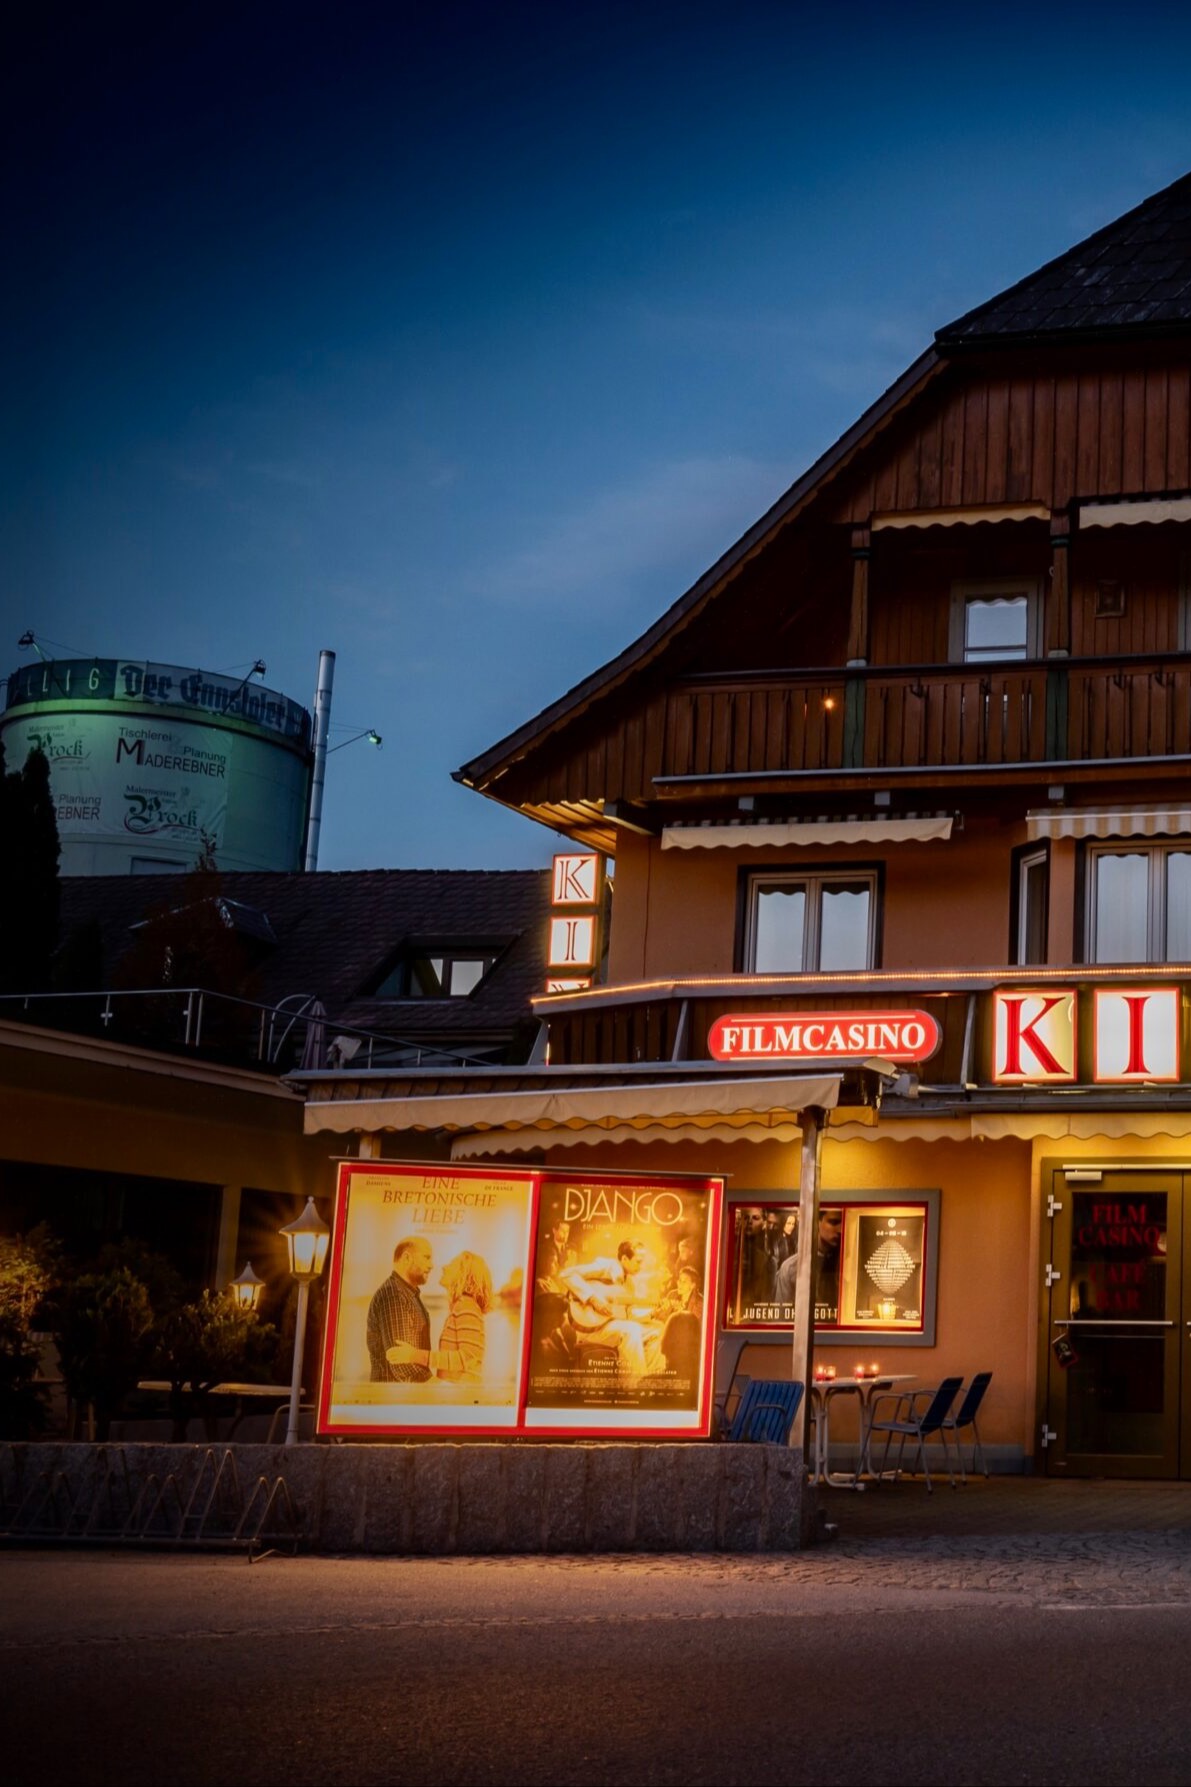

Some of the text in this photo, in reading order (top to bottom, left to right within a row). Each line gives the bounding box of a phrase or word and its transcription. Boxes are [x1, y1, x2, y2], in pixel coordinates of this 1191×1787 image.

[120, 664, 171, 700] Der
[120, 727, 172, 741] Tischlerei
[116, 738, 225, 779] MADEREBNER
[183, 746, 226, 764] Planung
[56, 806, 99, 820] EBNER
[720, 1022, 926, 1053] FILMCASINO
[421, 1177, 460, 1190] EINE
[382, 1189, 497, 1207] BRETONISCHE
[563, 1187, 684, 1226] DJANGO
[412, 1207, 467, 1225] LIEBE
[1092, 1203, 1147, 1225] FILM
[1079, 1225, 1161, 1249] CASINO
[1095, 1288, 1141, 1312] BAR
[743, 1307, 781, 1320] JUGEND
[813, 1307, 838, 1320] GOTT
